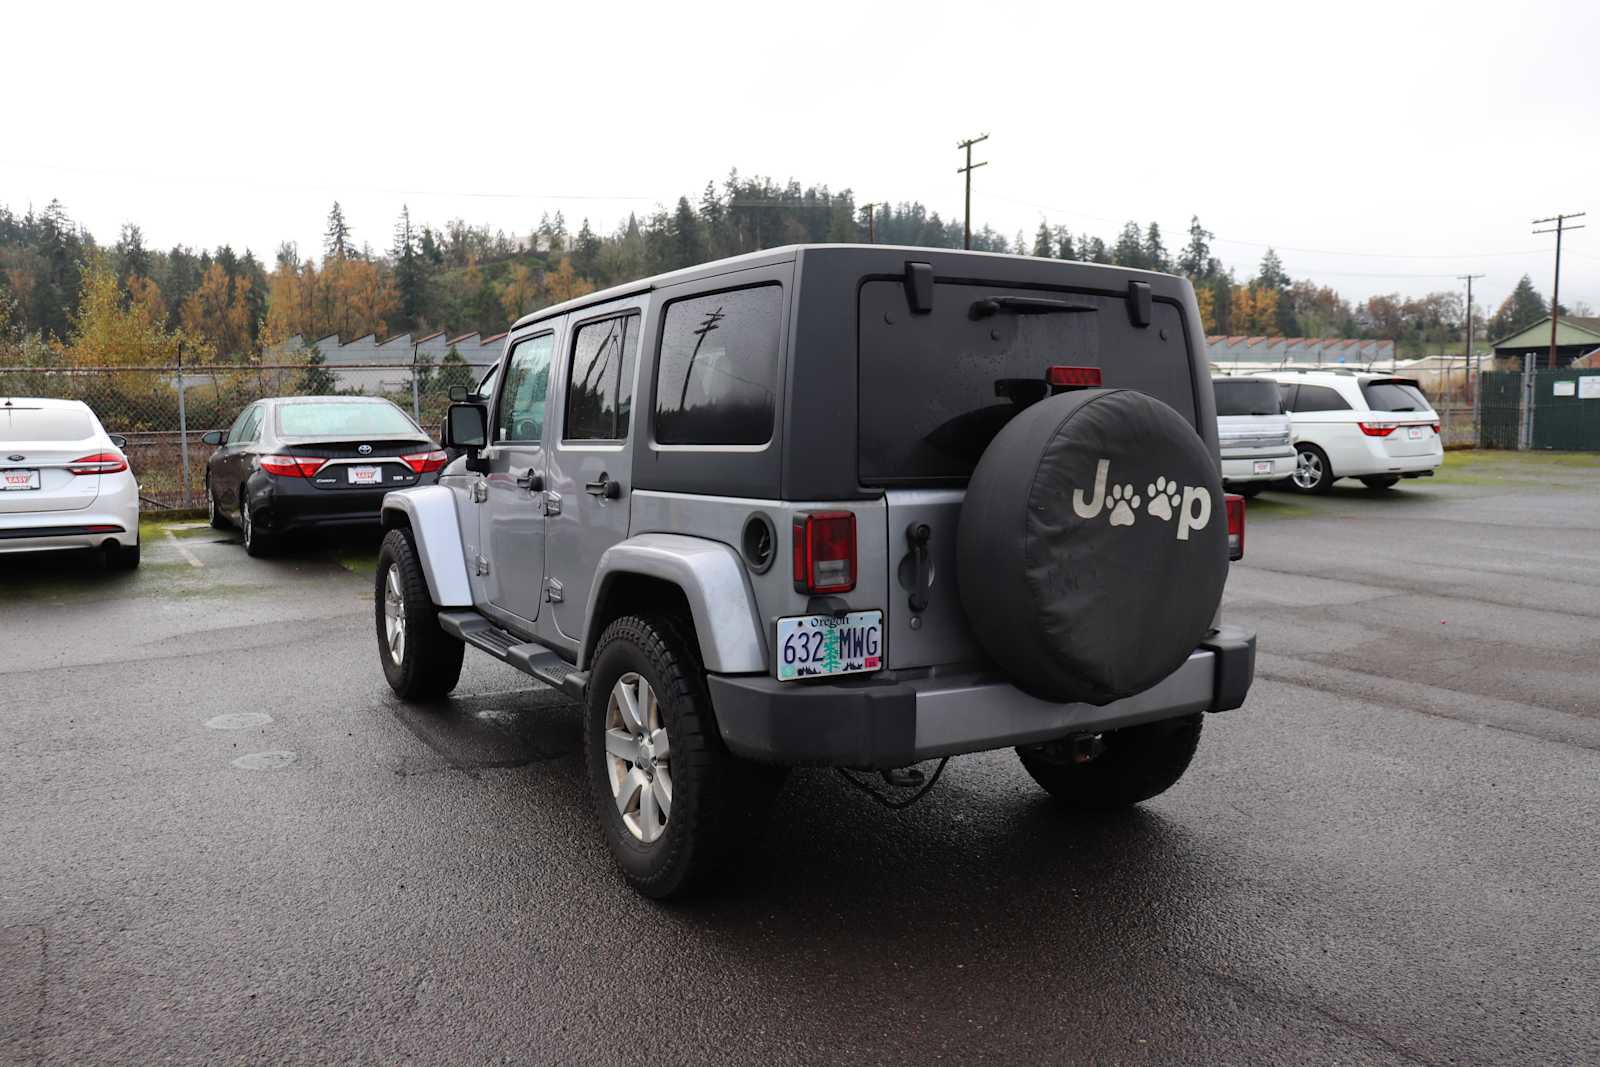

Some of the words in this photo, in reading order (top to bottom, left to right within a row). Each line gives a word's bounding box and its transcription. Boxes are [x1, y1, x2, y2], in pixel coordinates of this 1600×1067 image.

[811, 616, 849, 629] Oregon
[783, 631, 824, 665] 632
[839, 626, 878, 660] MWG
